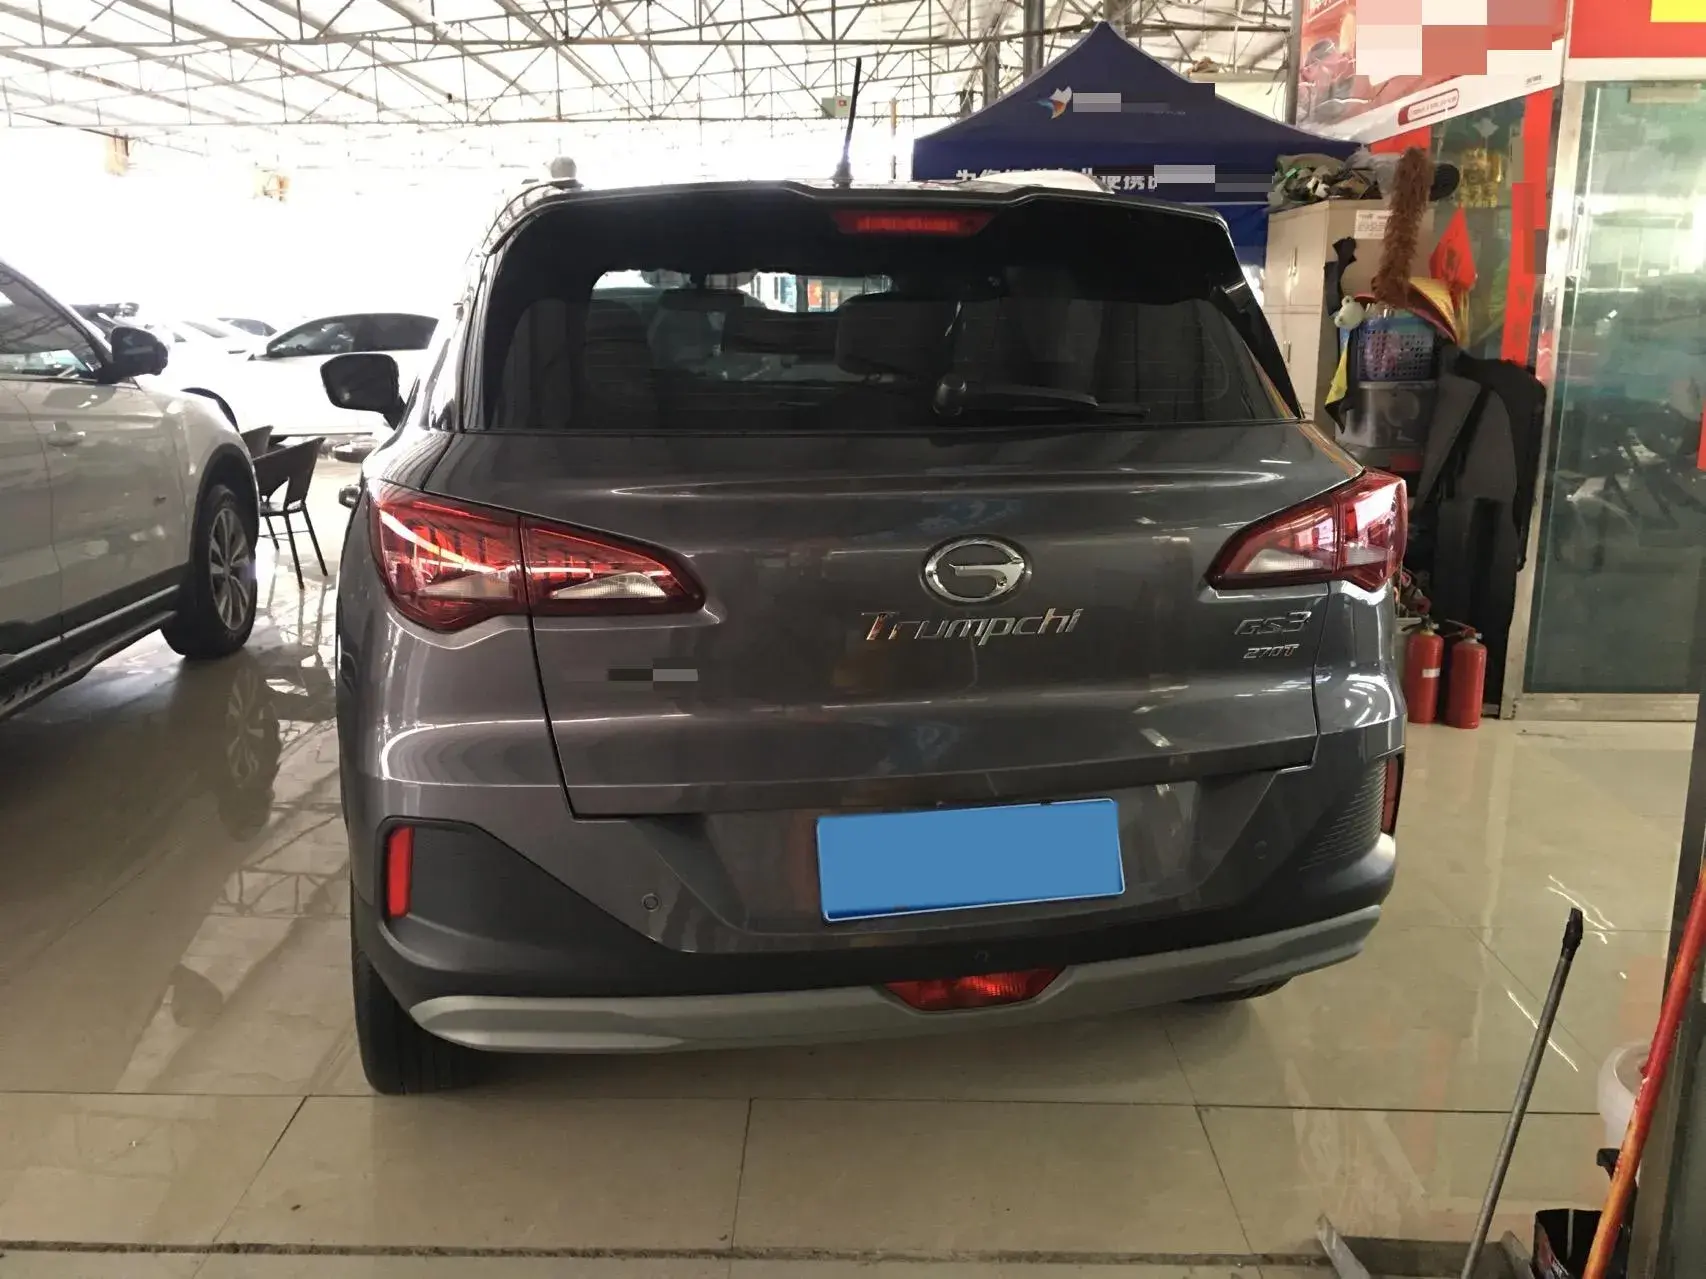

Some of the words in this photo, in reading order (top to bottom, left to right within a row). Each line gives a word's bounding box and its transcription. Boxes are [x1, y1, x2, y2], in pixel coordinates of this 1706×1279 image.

[861, 608, 1084, 646] Trumpchi
[1234, 611, 1312, 635] GS3
[1243, 643, 1300, 659] 270T
